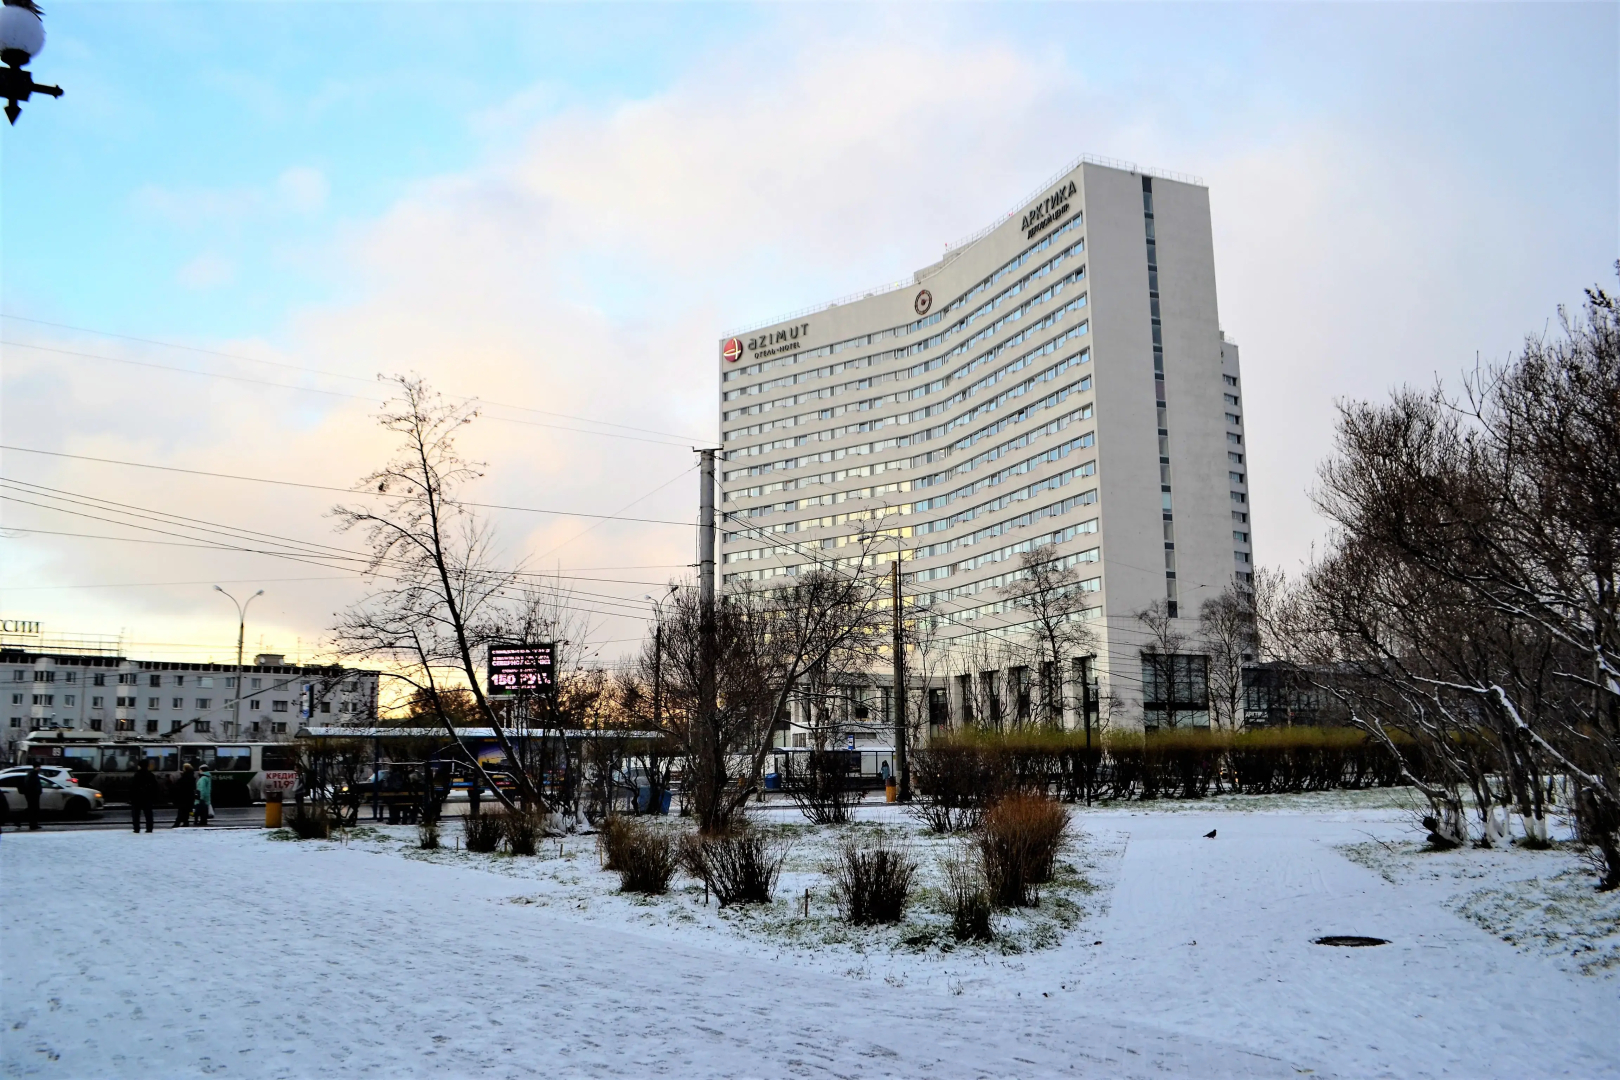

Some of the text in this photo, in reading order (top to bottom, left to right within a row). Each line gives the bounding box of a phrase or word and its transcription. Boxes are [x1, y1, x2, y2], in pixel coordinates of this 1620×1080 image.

[1021, 180, 1077, 231] АРКТИКА
[1052, 203, 1070, 221] ЦЕНТР
[491, 674, 517, 685] 150
[266, 772, 299, 780] КРЕДИТ
